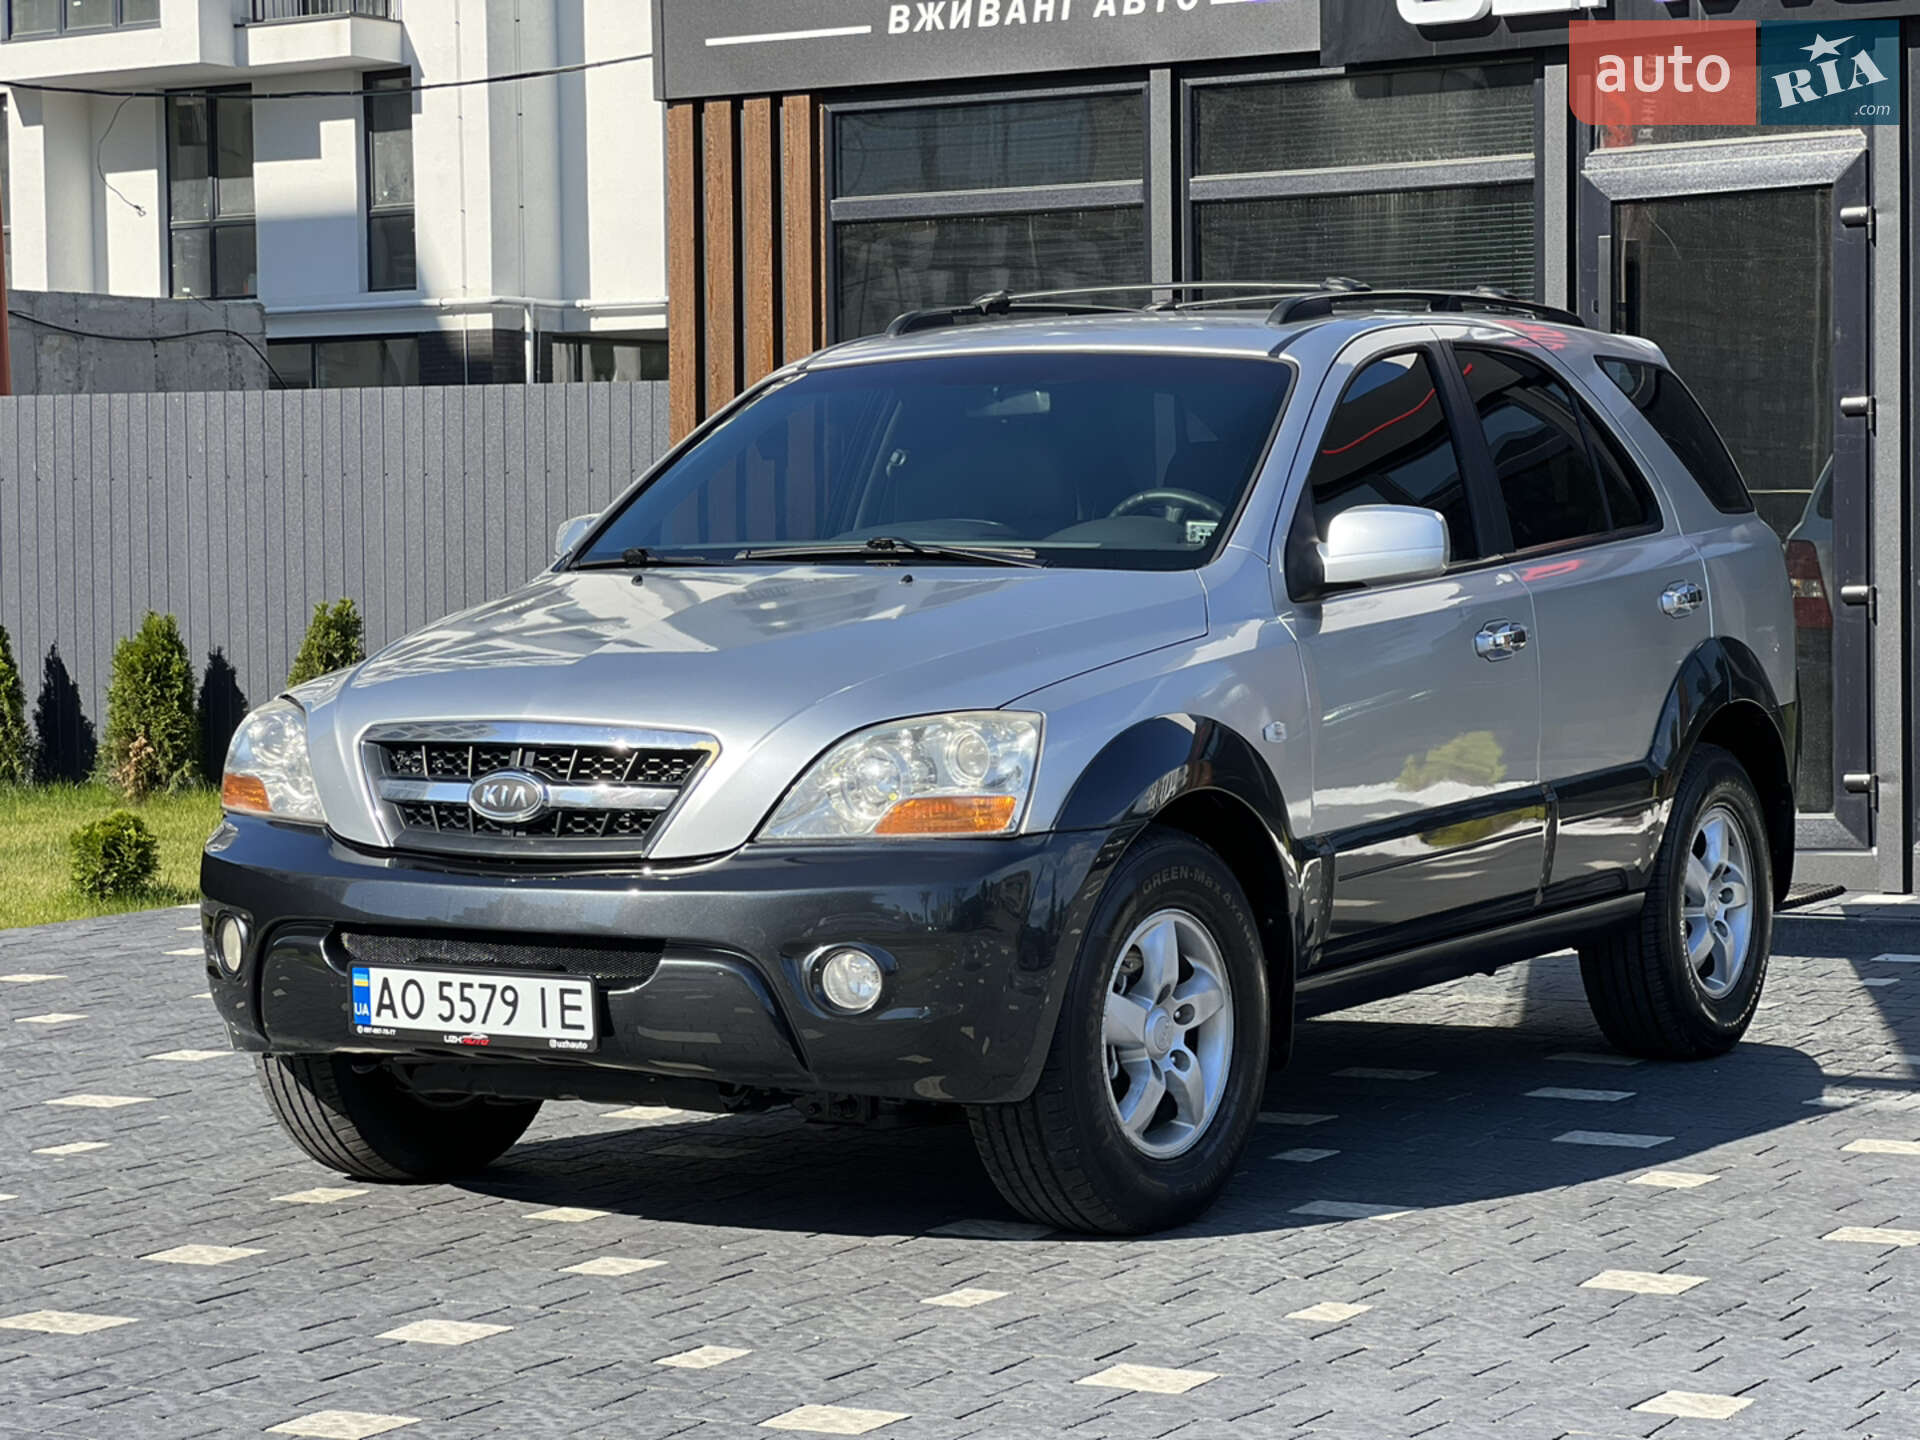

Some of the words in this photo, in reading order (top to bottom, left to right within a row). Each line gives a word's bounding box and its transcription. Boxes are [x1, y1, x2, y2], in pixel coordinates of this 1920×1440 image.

[888, 0, 1071, 34] ВЖИВАНІ
[481, 784, 528, 807] KIA
[354, 1002, 370, 1016] UA
[375, 977, 425, 1020] AO
[438, 981, 519, 1026] 5579
[540, 986, 585, 1031] IE
